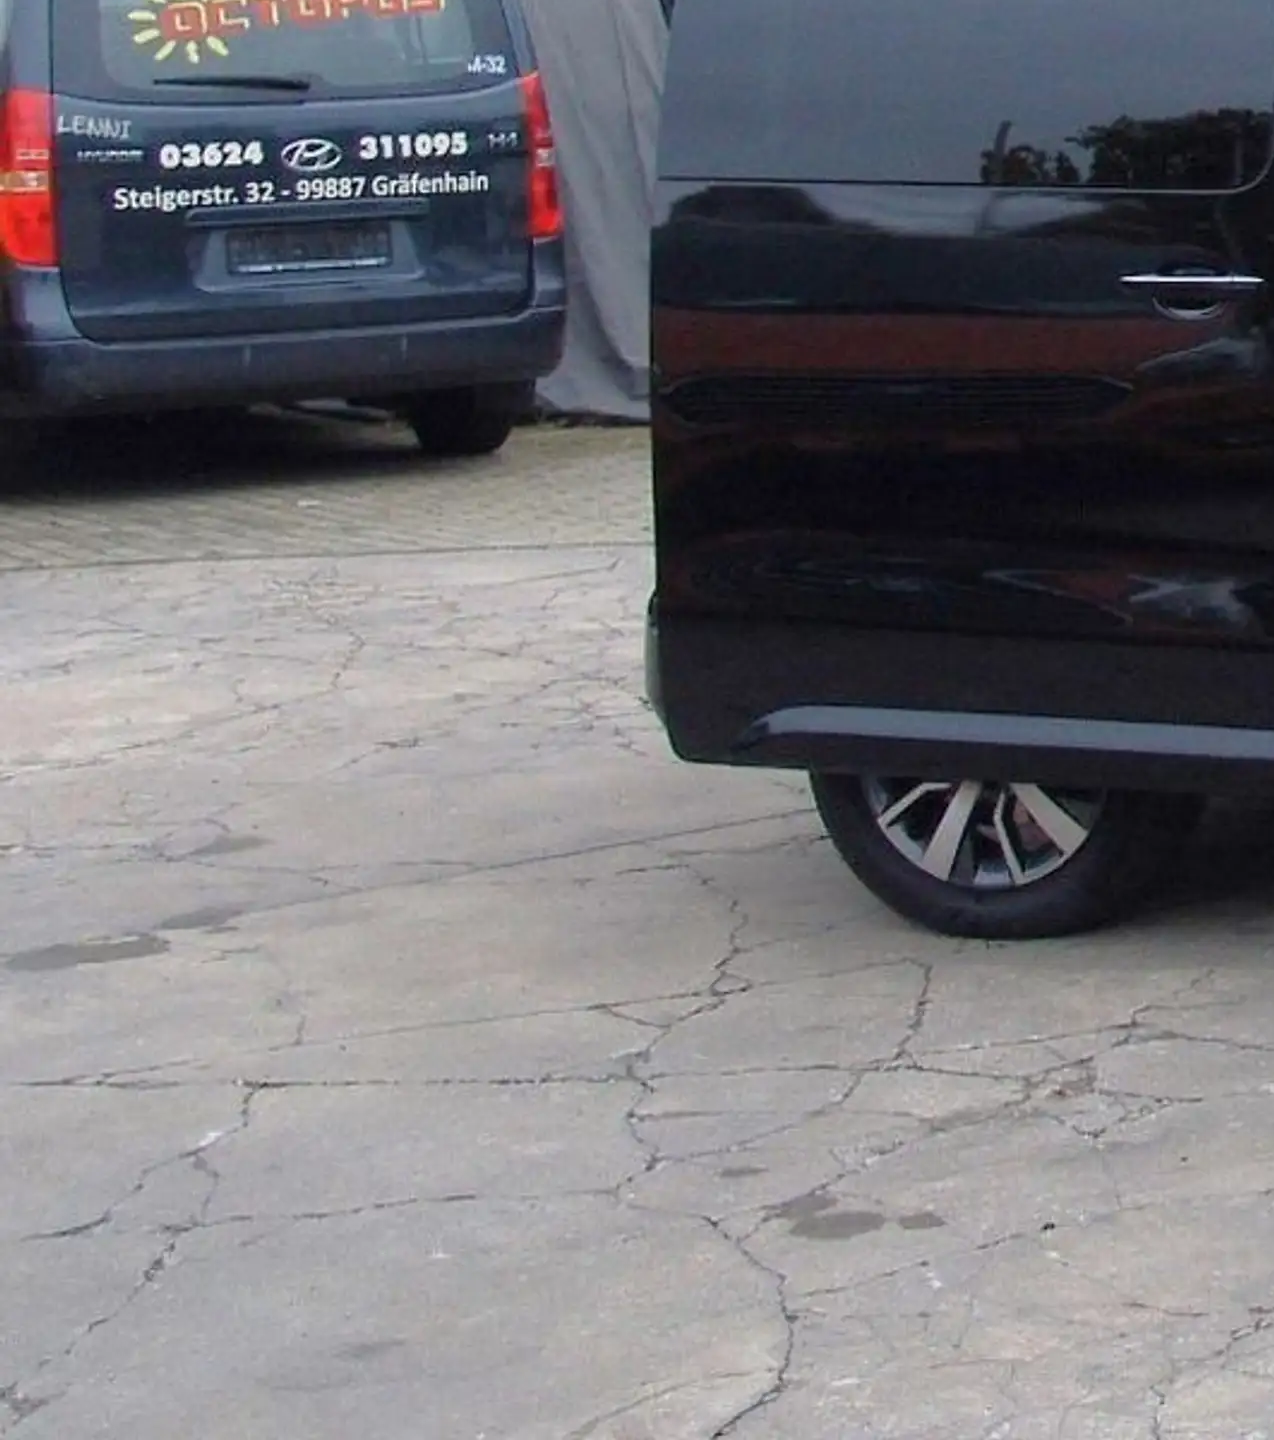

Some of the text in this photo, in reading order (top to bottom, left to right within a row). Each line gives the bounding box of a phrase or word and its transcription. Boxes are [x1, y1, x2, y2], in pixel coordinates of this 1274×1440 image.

[159, 140, 264, 168] 03624
[359, 131, 469, 160] 311095
[113, 184, 239, 212] Steigerstr.
[244, 181, 275, 203] 32
[295, 176, 366, 201] 99887
[371, 170, 490, 197] Gräfenhain
